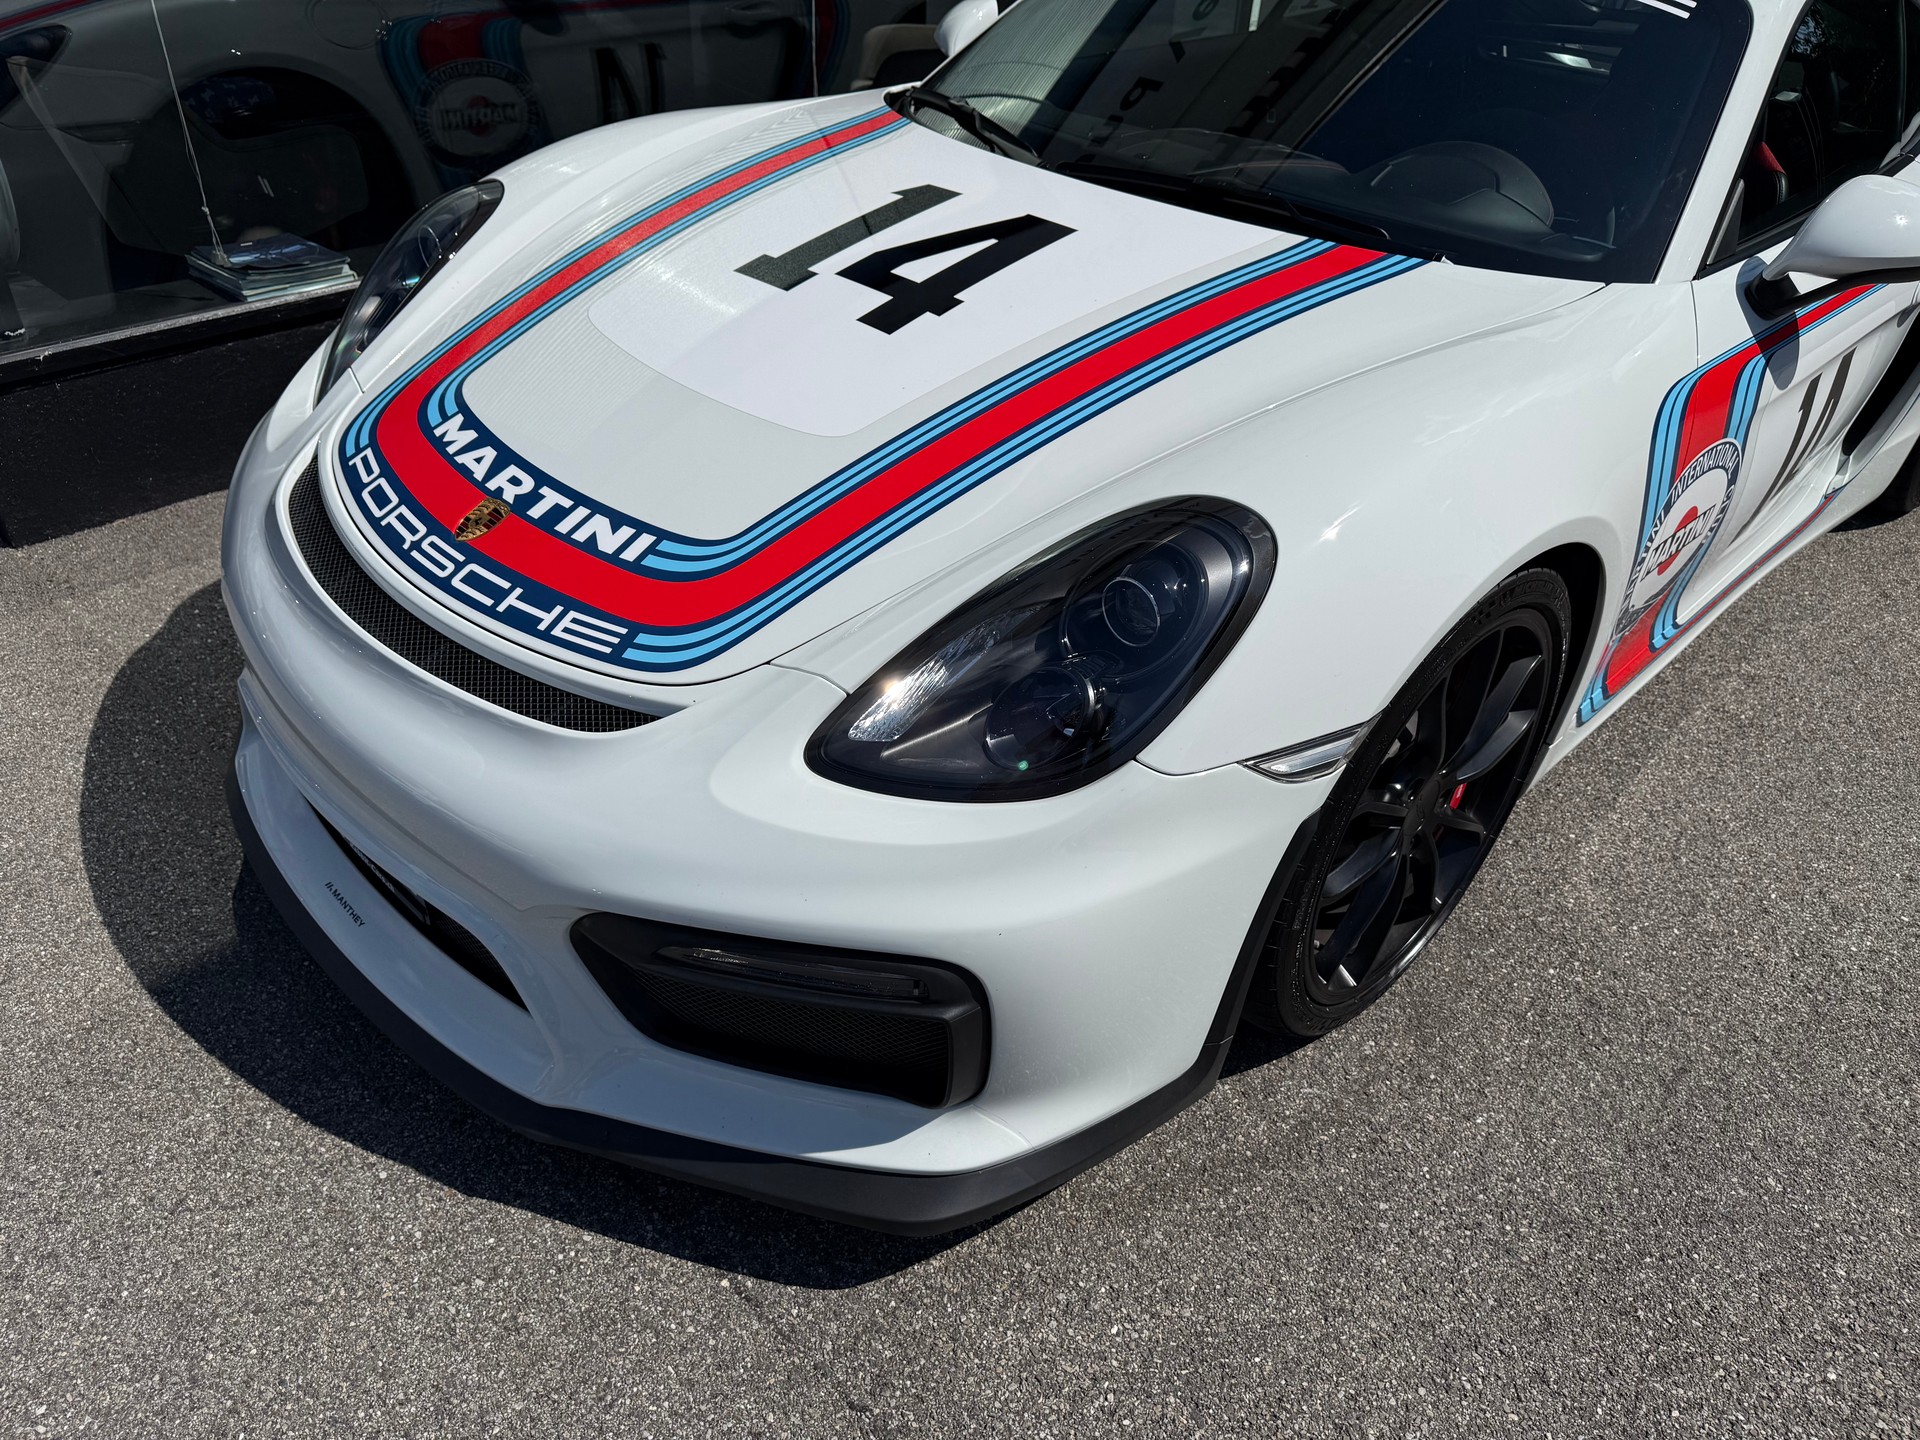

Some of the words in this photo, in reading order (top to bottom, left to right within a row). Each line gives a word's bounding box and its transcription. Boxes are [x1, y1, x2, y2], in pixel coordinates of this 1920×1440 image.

[734, 184, 1078, 334] 14
[433, 412, 657, 562] MARTINI
[1638, 506, 1715, 581] MARTINI
[1670, 443, 1739, 507] INTERNATIONAL
[348, 447, 629, 654] PORSCHE
